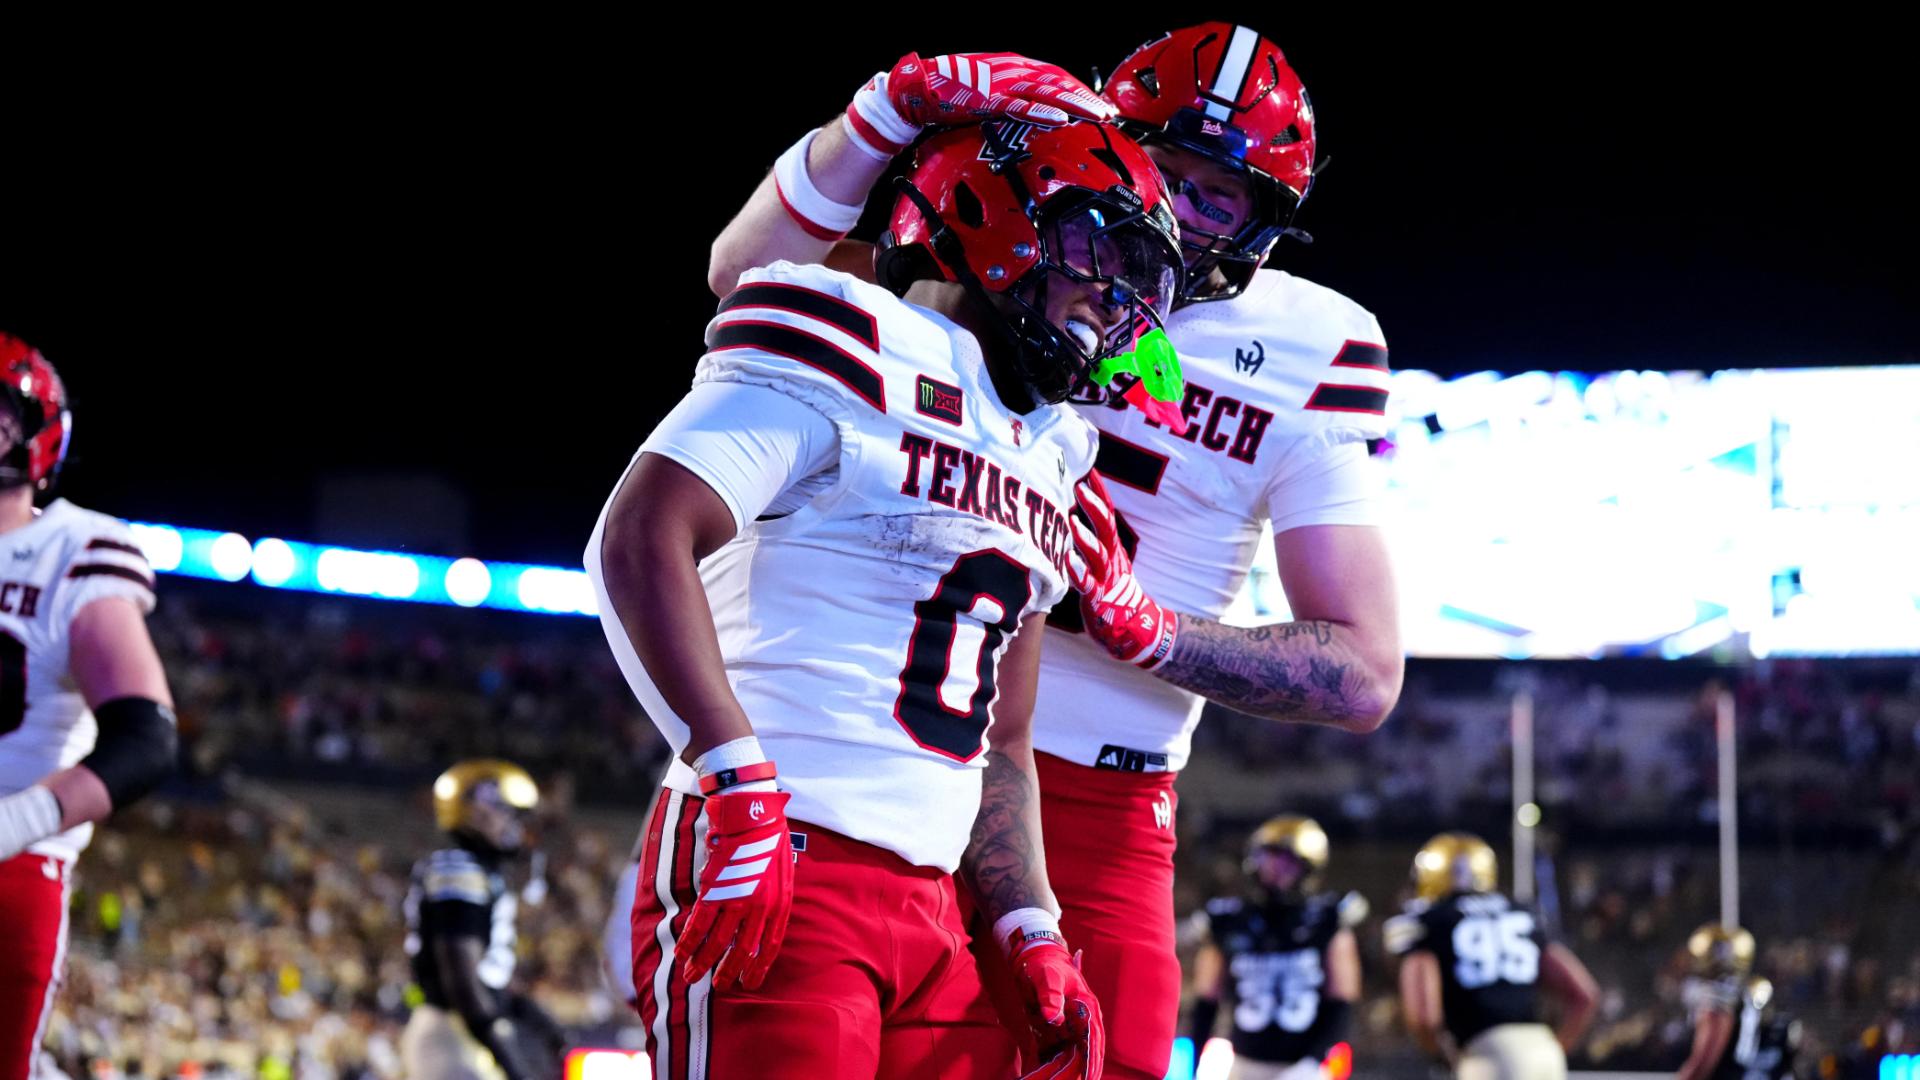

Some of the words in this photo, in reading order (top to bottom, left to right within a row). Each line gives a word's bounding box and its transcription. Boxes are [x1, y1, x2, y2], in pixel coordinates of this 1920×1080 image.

[1201, 119, 1223, 136] Tech
[1143, 380, 1275, 466] ECH
[900, 431, 1023, 534] TEXAS
[893, 547, 1032, 764] 0
[1024, 931, 1055, 943] JESUS
[1452, 911, 1540, 989] 95
